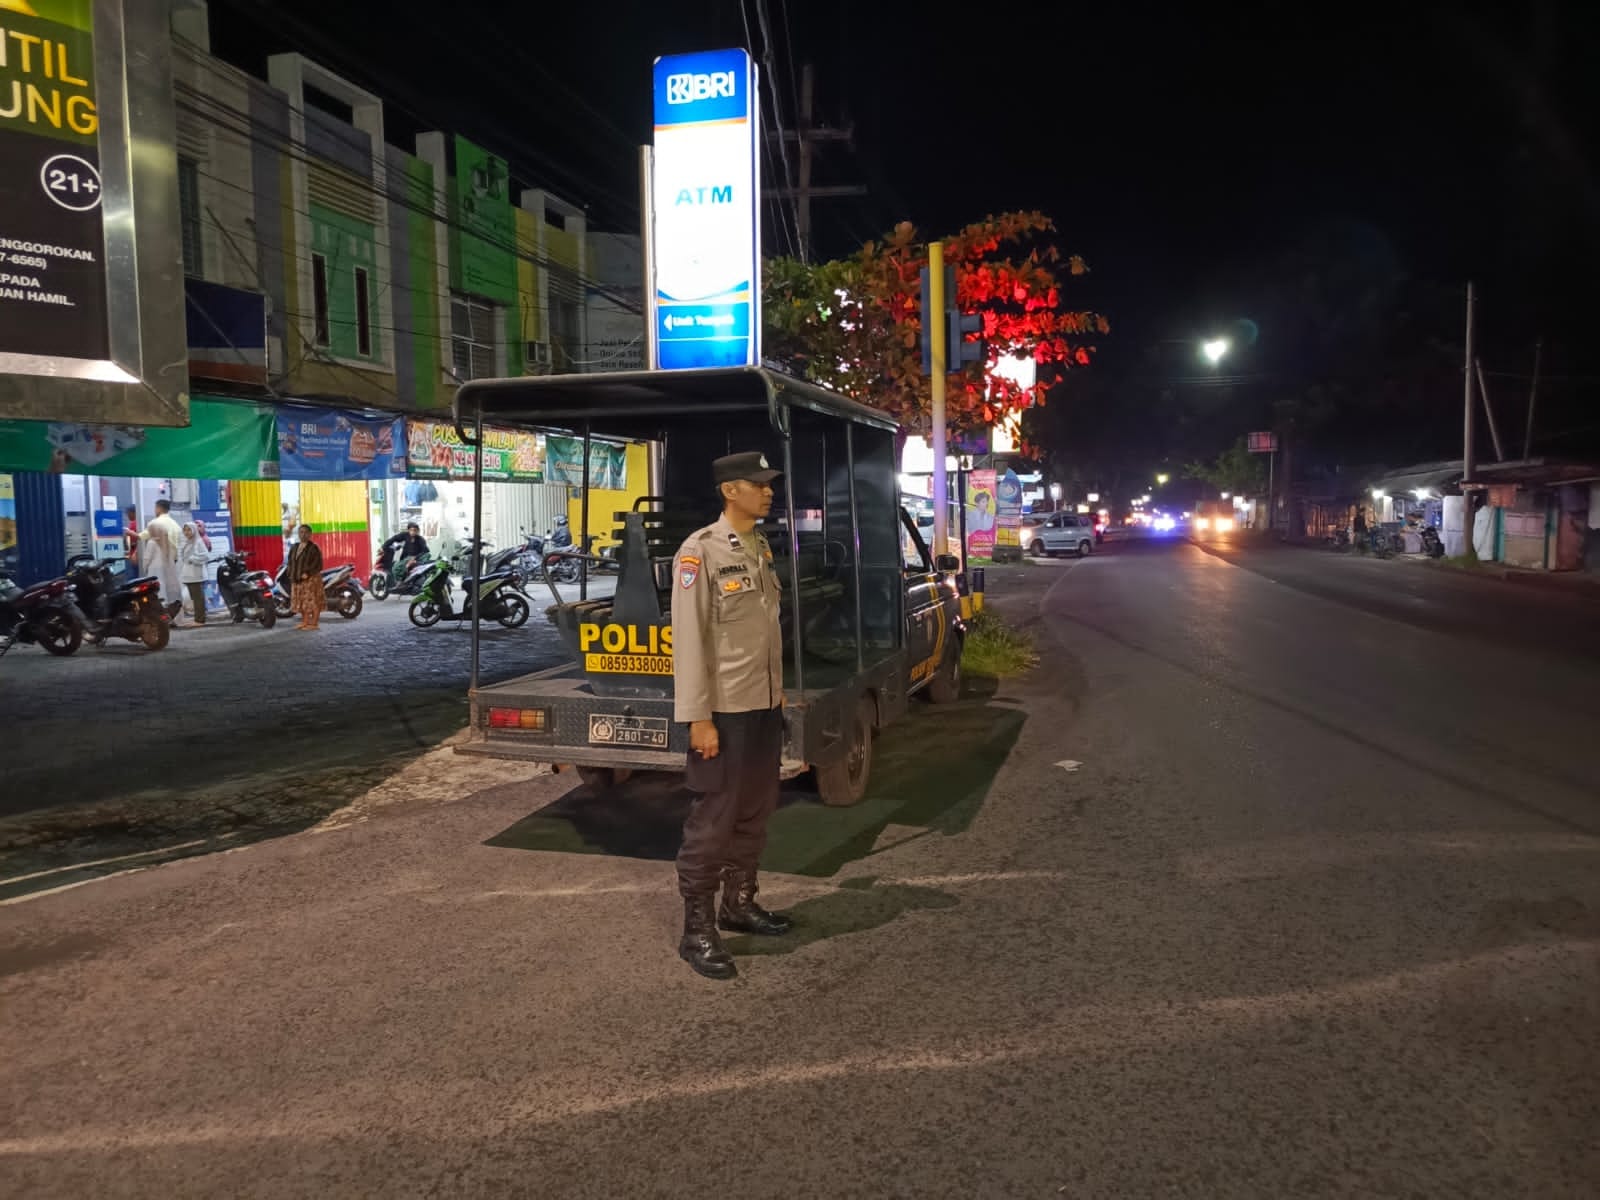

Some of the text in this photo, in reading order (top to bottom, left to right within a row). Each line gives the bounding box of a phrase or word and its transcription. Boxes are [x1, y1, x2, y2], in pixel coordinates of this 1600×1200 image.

[49, 169, 99, 195] 21+
[675, 185, 732, 206] ATM
[600, 655, 674, 673] 0859338009
